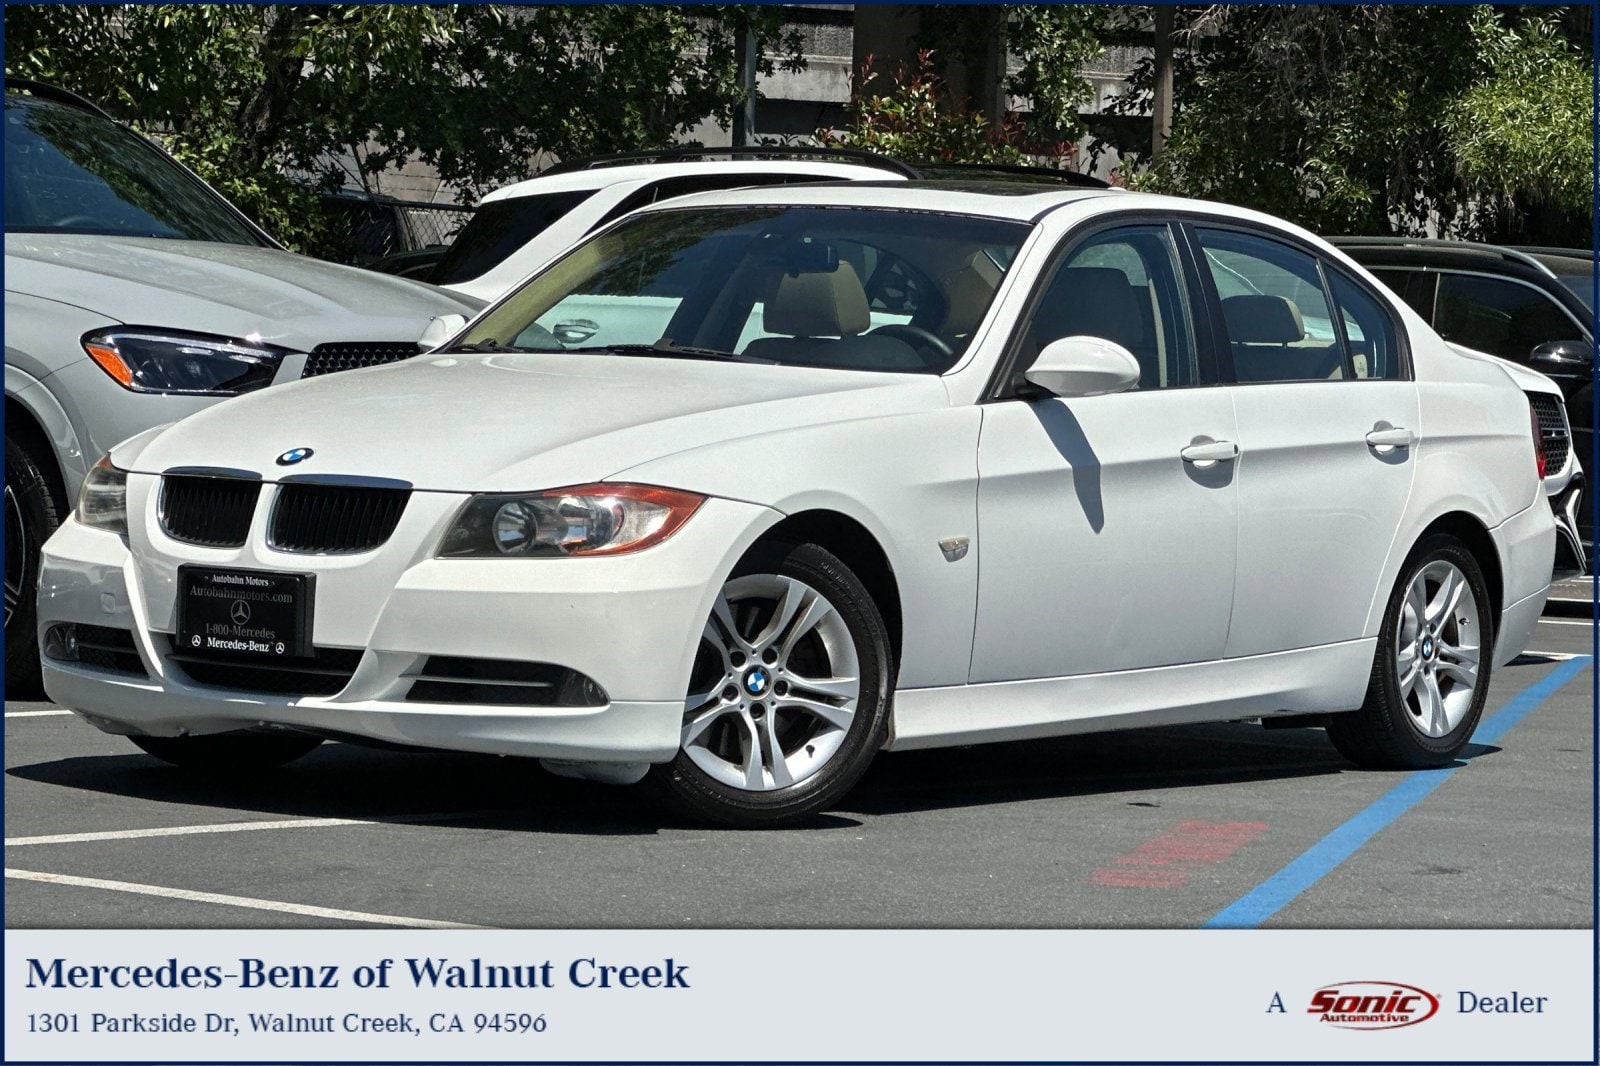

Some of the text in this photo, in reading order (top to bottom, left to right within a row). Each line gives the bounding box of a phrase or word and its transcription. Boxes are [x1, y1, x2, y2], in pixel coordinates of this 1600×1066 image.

[211, 573, 269, 587] Autobahn Motors
[190, 585, 293, 603] Autobahnmotors.com
[205, 623, 276, 639] 1-800-Mercedes
[207, 637, 270, 653] Mercedes-Benz
